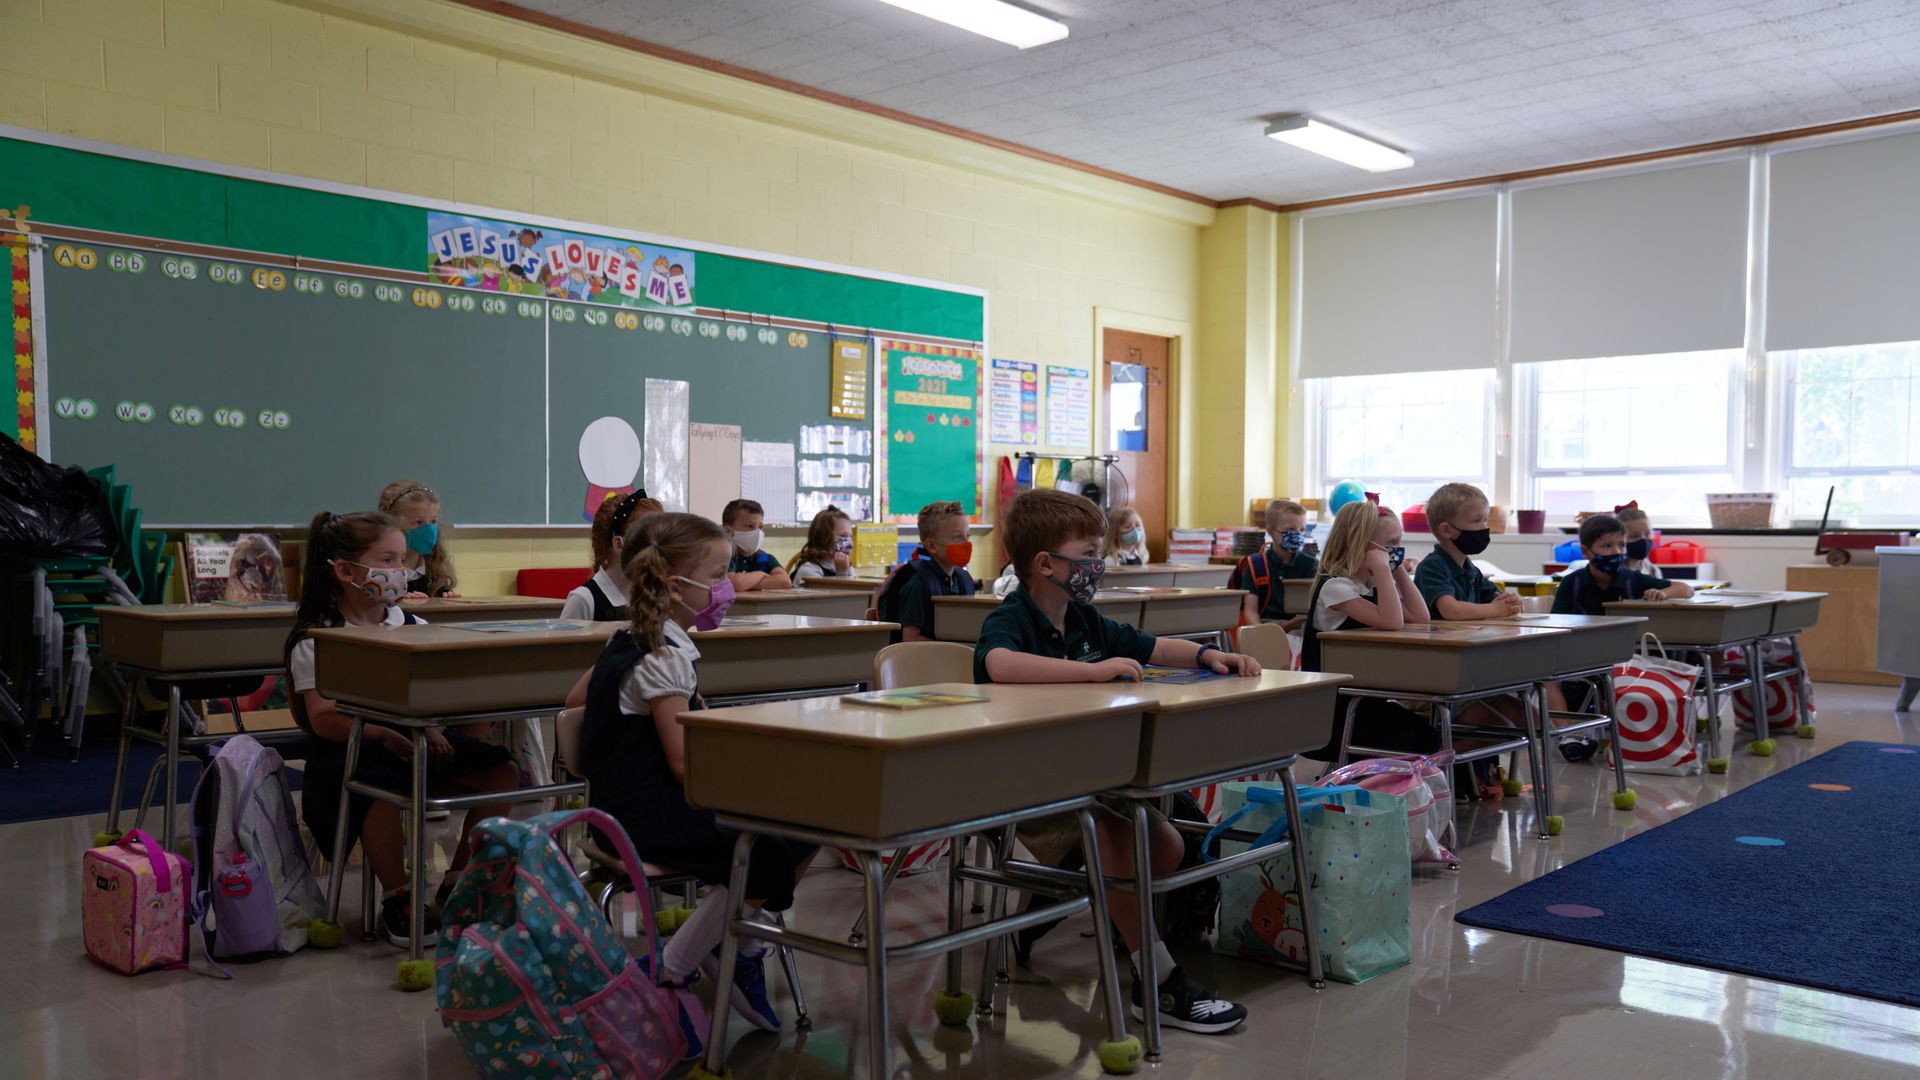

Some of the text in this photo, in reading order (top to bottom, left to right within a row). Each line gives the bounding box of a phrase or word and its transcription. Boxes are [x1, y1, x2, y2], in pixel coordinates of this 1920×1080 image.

[59, 249, 90, 265] Aa
[114, 255, 140, 270] Bb
[165, 261, 191, 275] Cc
[214, 266, 237, 281] Dd
[258, 272, 281, 287] Ee
[298, 277, 320, 292] Ff
[337, 282, 359, 297] Gg
[378, 286, 400, 299] Hh
[441, 232, 687, 300] JESUS LOVES ME
[61, 402, 284, 425] Vv Ww Xx Yy Zz
[197, 566, 217, 575] Long
